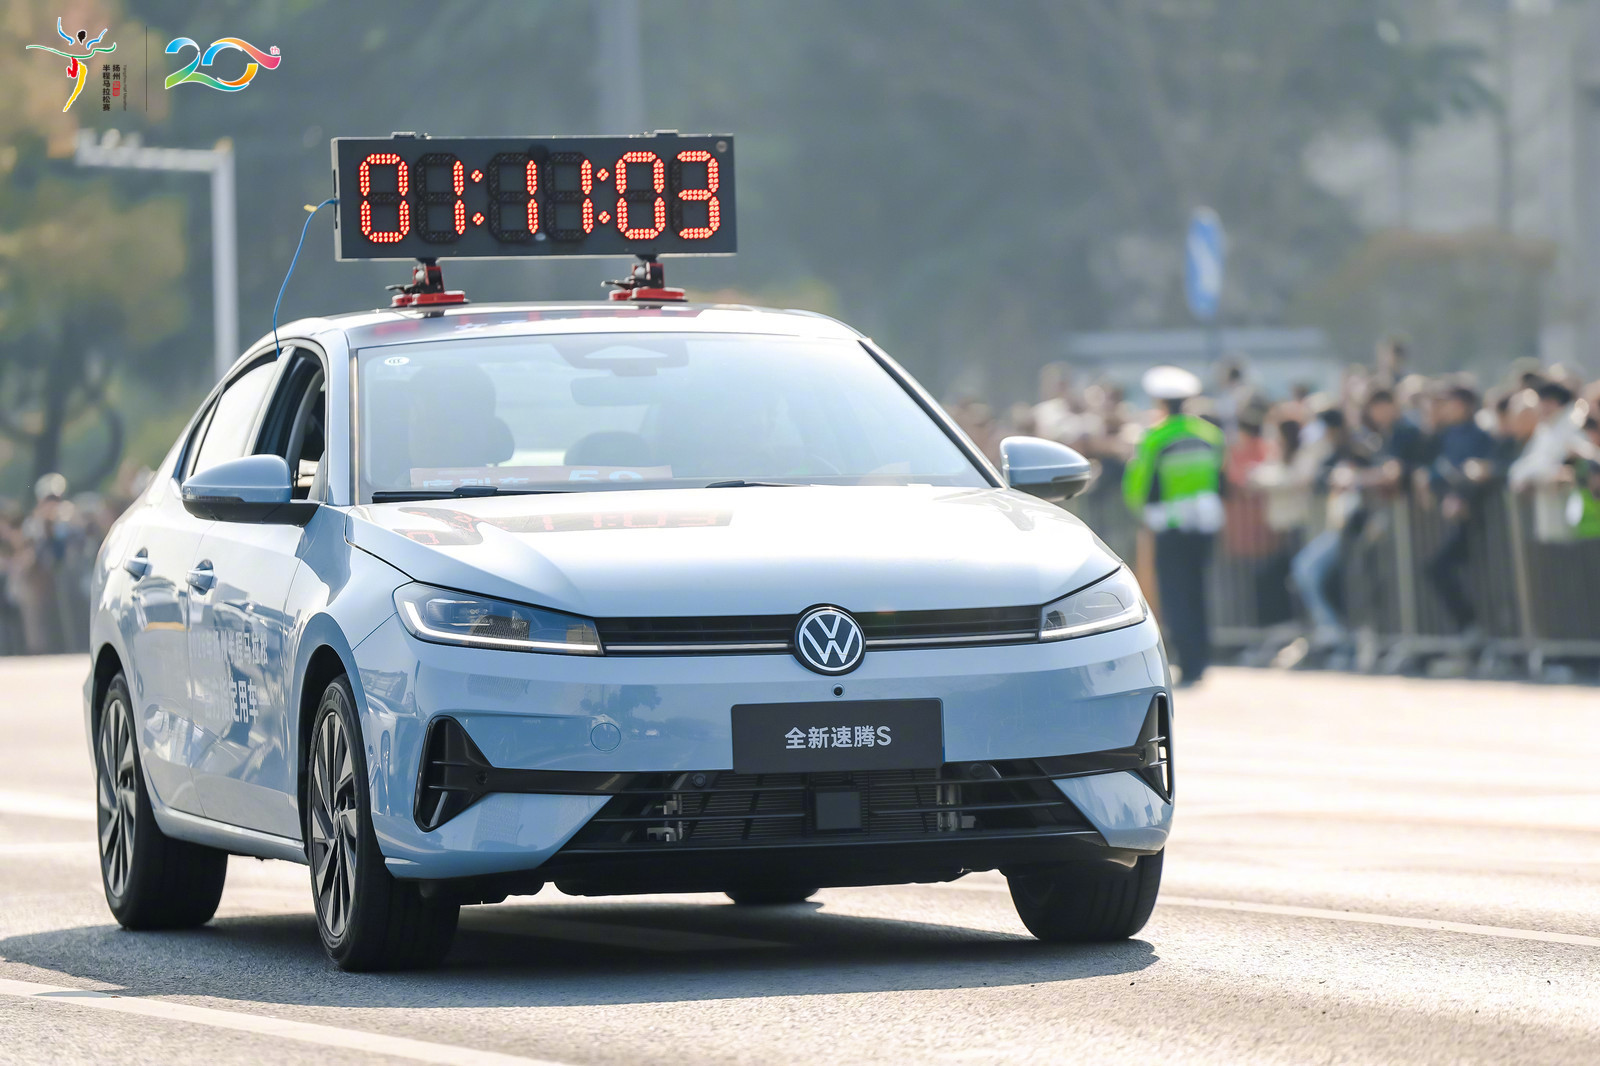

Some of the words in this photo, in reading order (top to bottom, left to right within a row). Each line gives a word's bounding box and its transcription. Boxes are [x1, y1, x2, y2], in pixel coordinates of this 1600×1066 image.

[359, 150, 721, 243] 01:11:03
[784, 725, 892, 750] 全新速腾S
